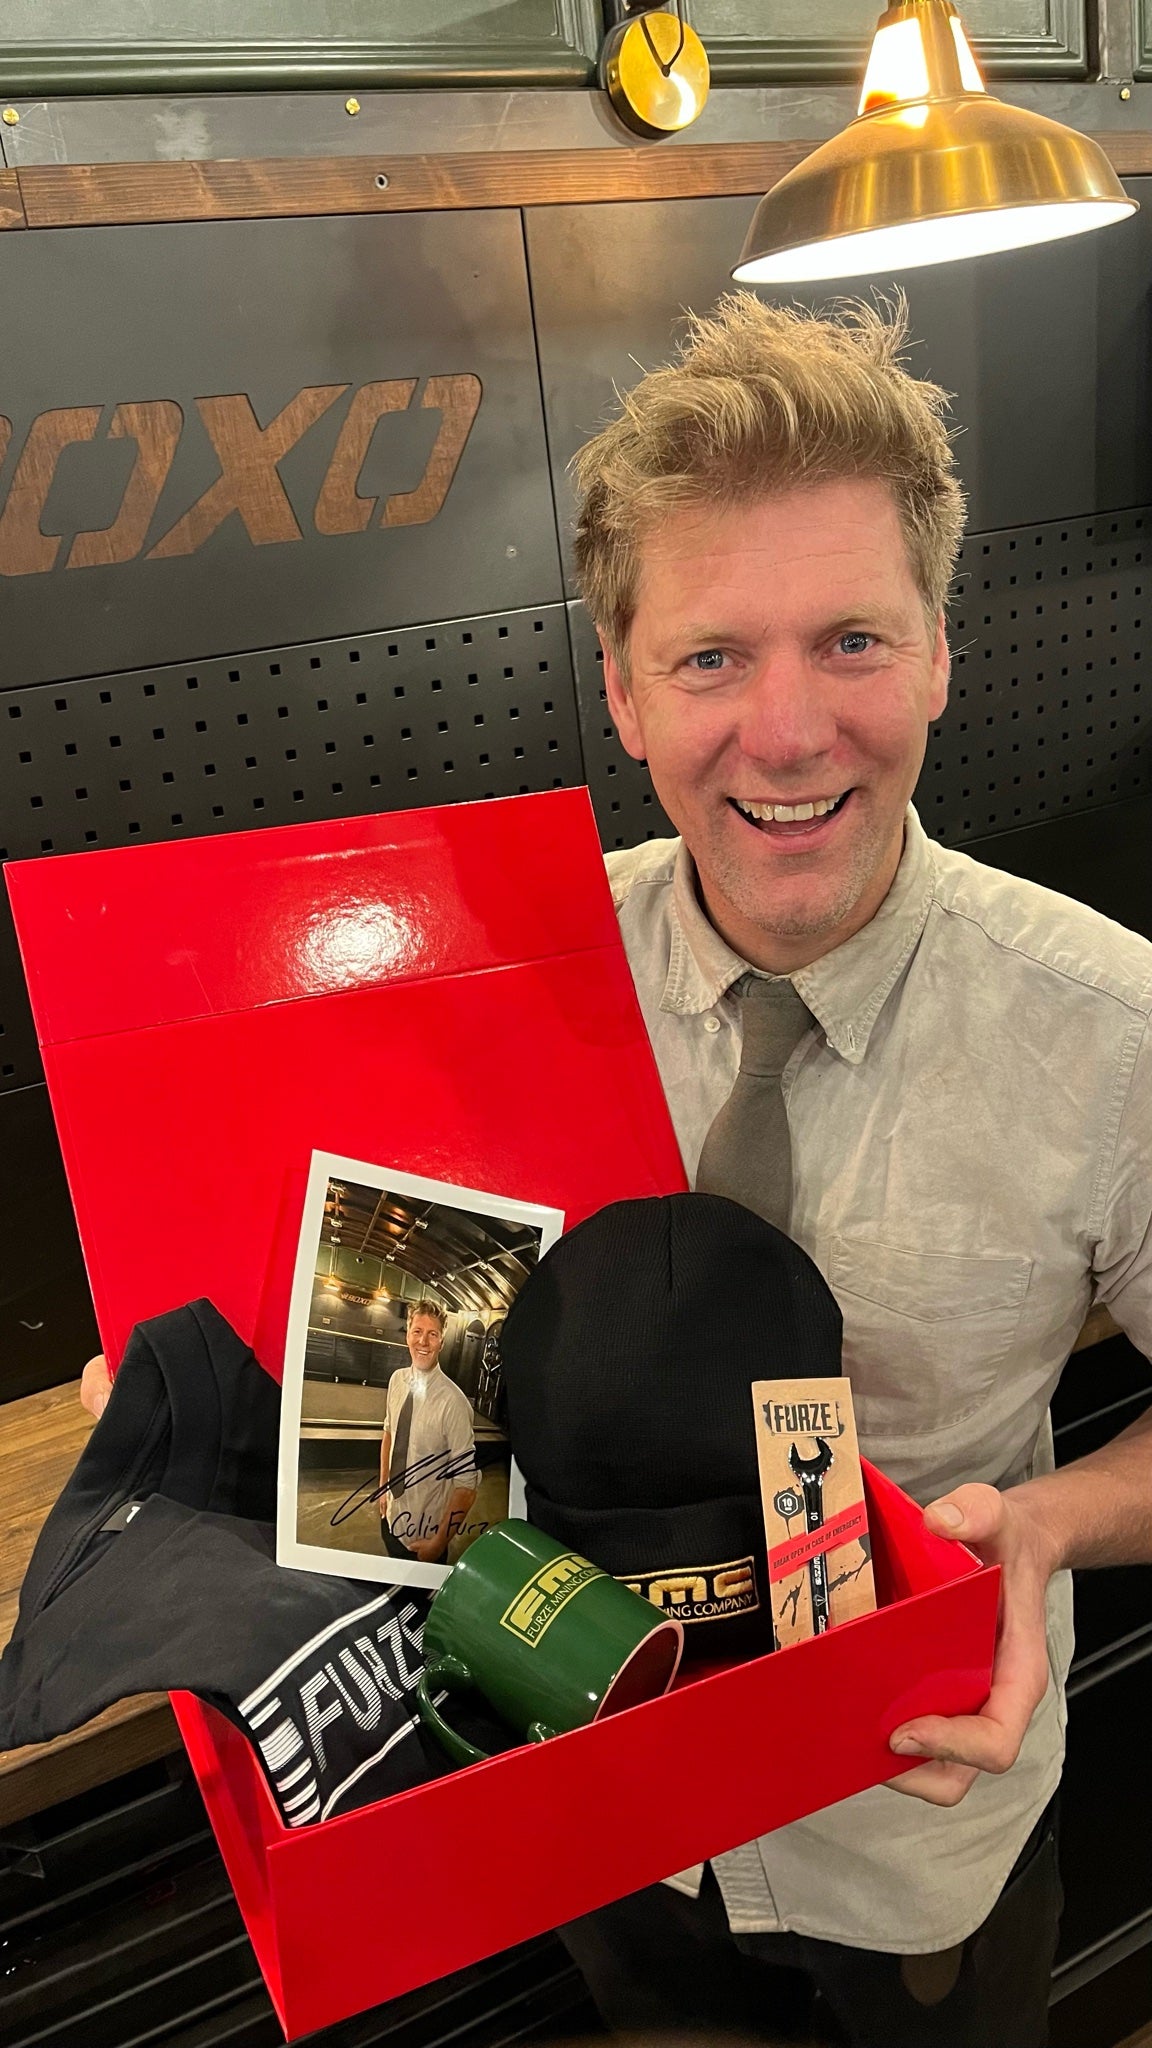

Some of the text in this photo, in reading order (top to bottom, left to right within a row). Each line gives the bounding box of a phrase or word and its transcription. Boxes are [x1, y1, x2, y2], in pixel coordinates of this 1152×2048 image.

[0, 372, 484, 577] OXO
[774, 1403, 833, 1433] FURZE
[782, 1497, 793, 1507] 10
[391, 1510, 489, 1538] Colin Furz
[773, 1515, 862, 1569] BREAK OPEN IN CASE OF EMERGENCY
[526, 1576, 583, 1639] FURZE MINING
[664, 1594, 753, 1618] ING COMPANY
